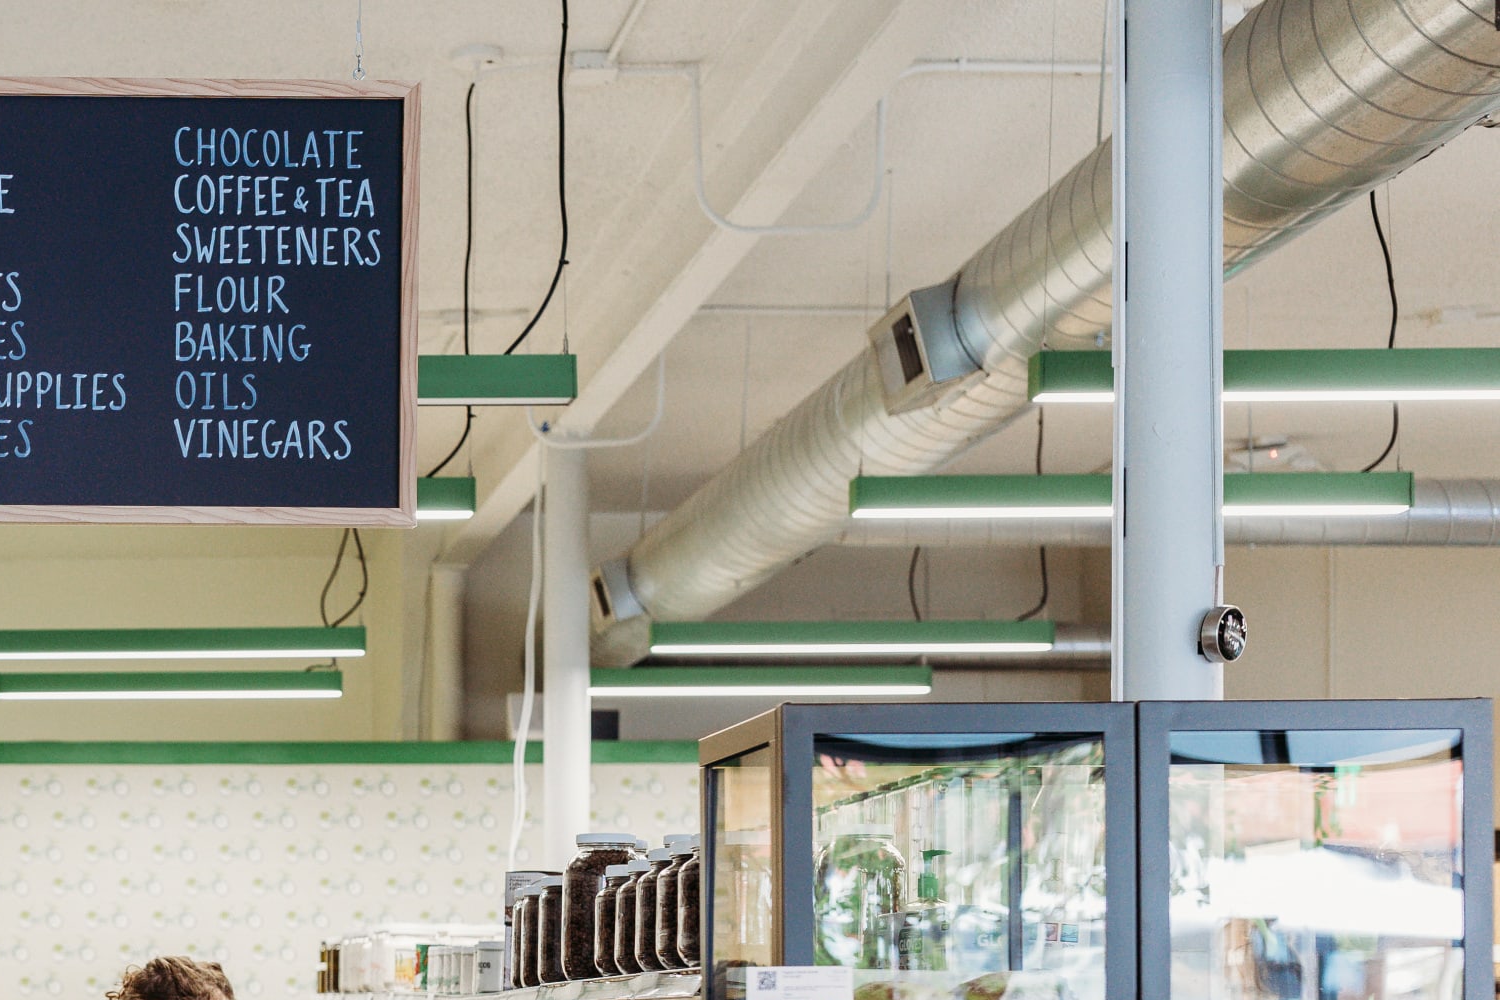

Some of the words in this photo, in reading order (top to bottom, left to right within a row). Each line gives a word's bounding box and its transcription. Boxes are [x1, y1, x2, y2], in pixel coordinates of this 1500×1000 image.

[174, 126, 364, 169] CHOCOLATE
[173, 174, 289, 217] COFFEE
[293, 186, 309, 213] &
[316, 178, 375, 218] TEA
[172, 222, 381, 267] SWEETENERS
[174, 273, 290, 314] FLOUR
[175, 321, 311, 363] BAKING
[175, 371, 257, 411] OILS
[174, 417, 352, 460] VINEGARS
